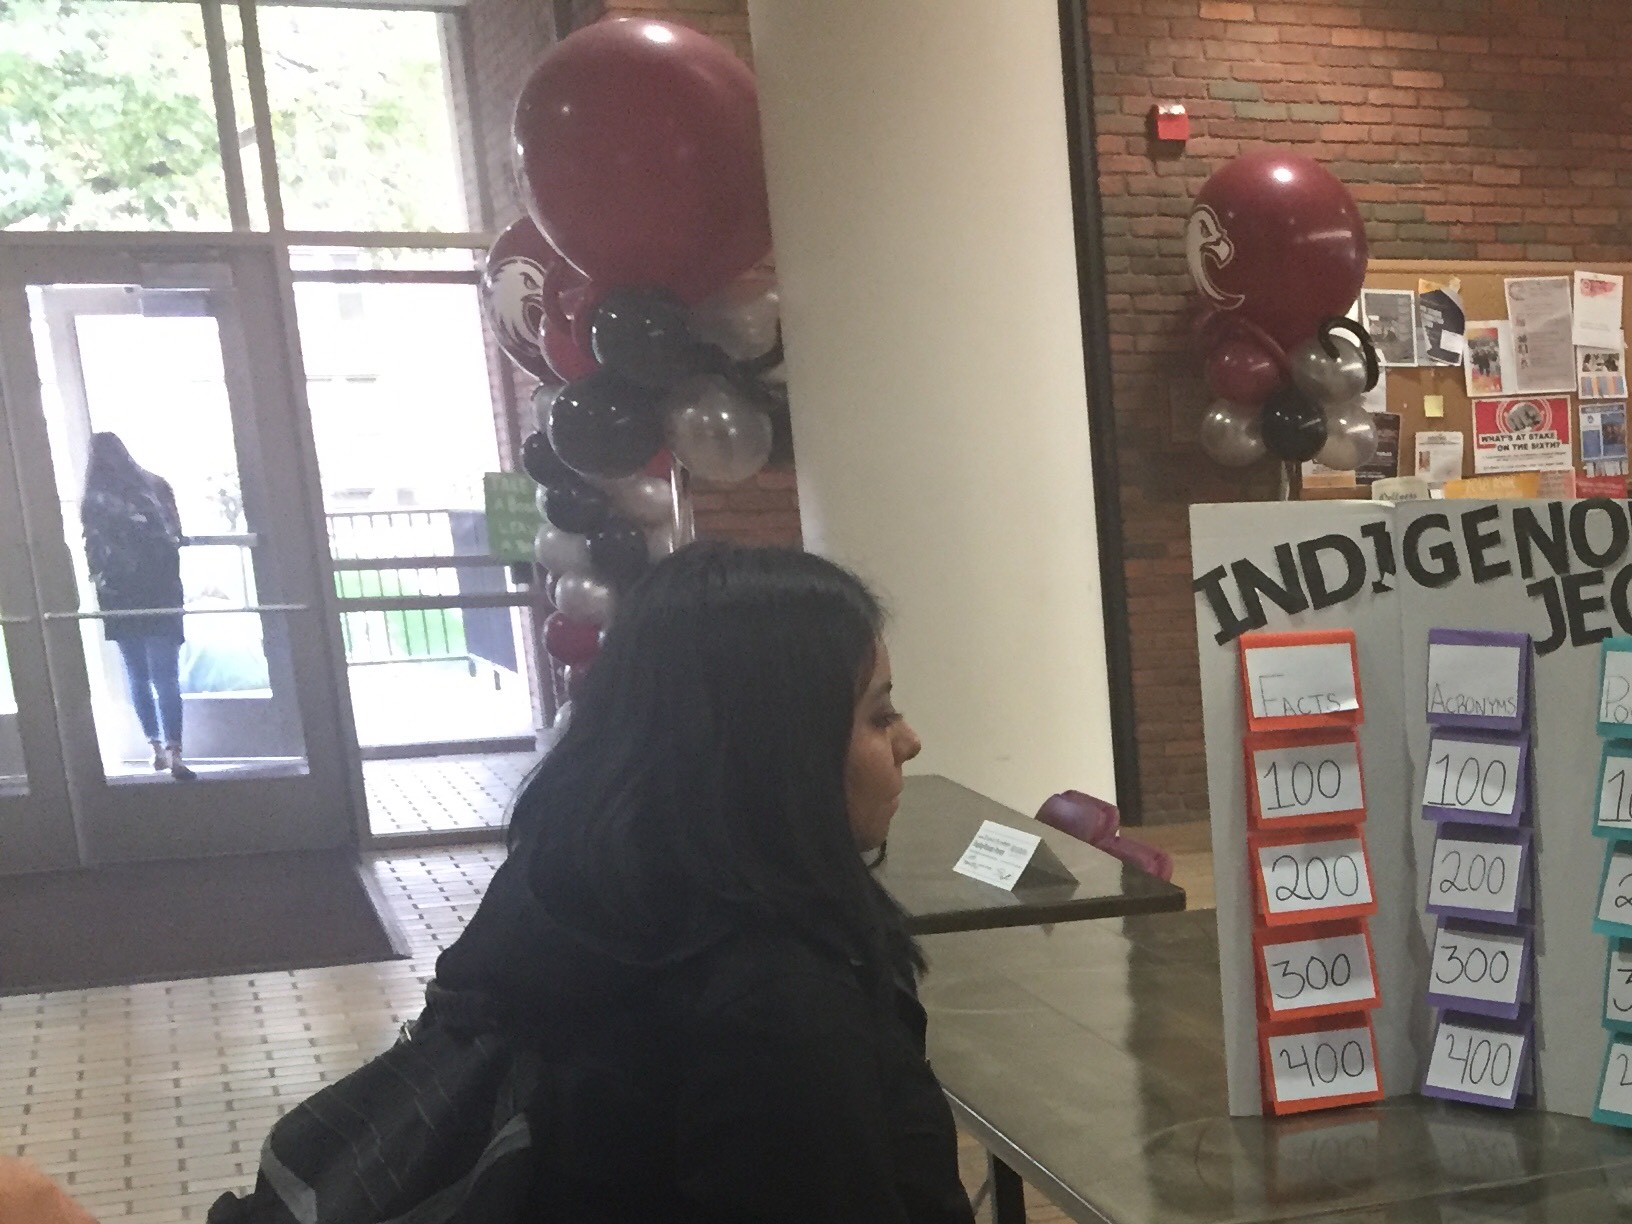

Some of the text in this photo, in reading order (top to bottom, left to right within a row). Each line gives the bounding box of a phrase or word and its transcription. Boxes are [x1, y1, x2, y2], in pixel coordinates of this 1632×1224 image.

[1496, 443, 1510, 452] ON
[1512, 442, 1529, 451] THE
[1515, 433, 1526, 442] AT
[1262, 759, 1342, 810] 100
[1425, 753, 1507, 807] 100
[1274, 854, 1360, 902] 200
[1438, 849, 1506, 896] 200
[1271, 954, 1352, 1000] 300
[1434, 944, 1510, 985] 300
[1279, 1040, 1366, 1088] 400
[1445, 1033, 1513, 1087] 400
